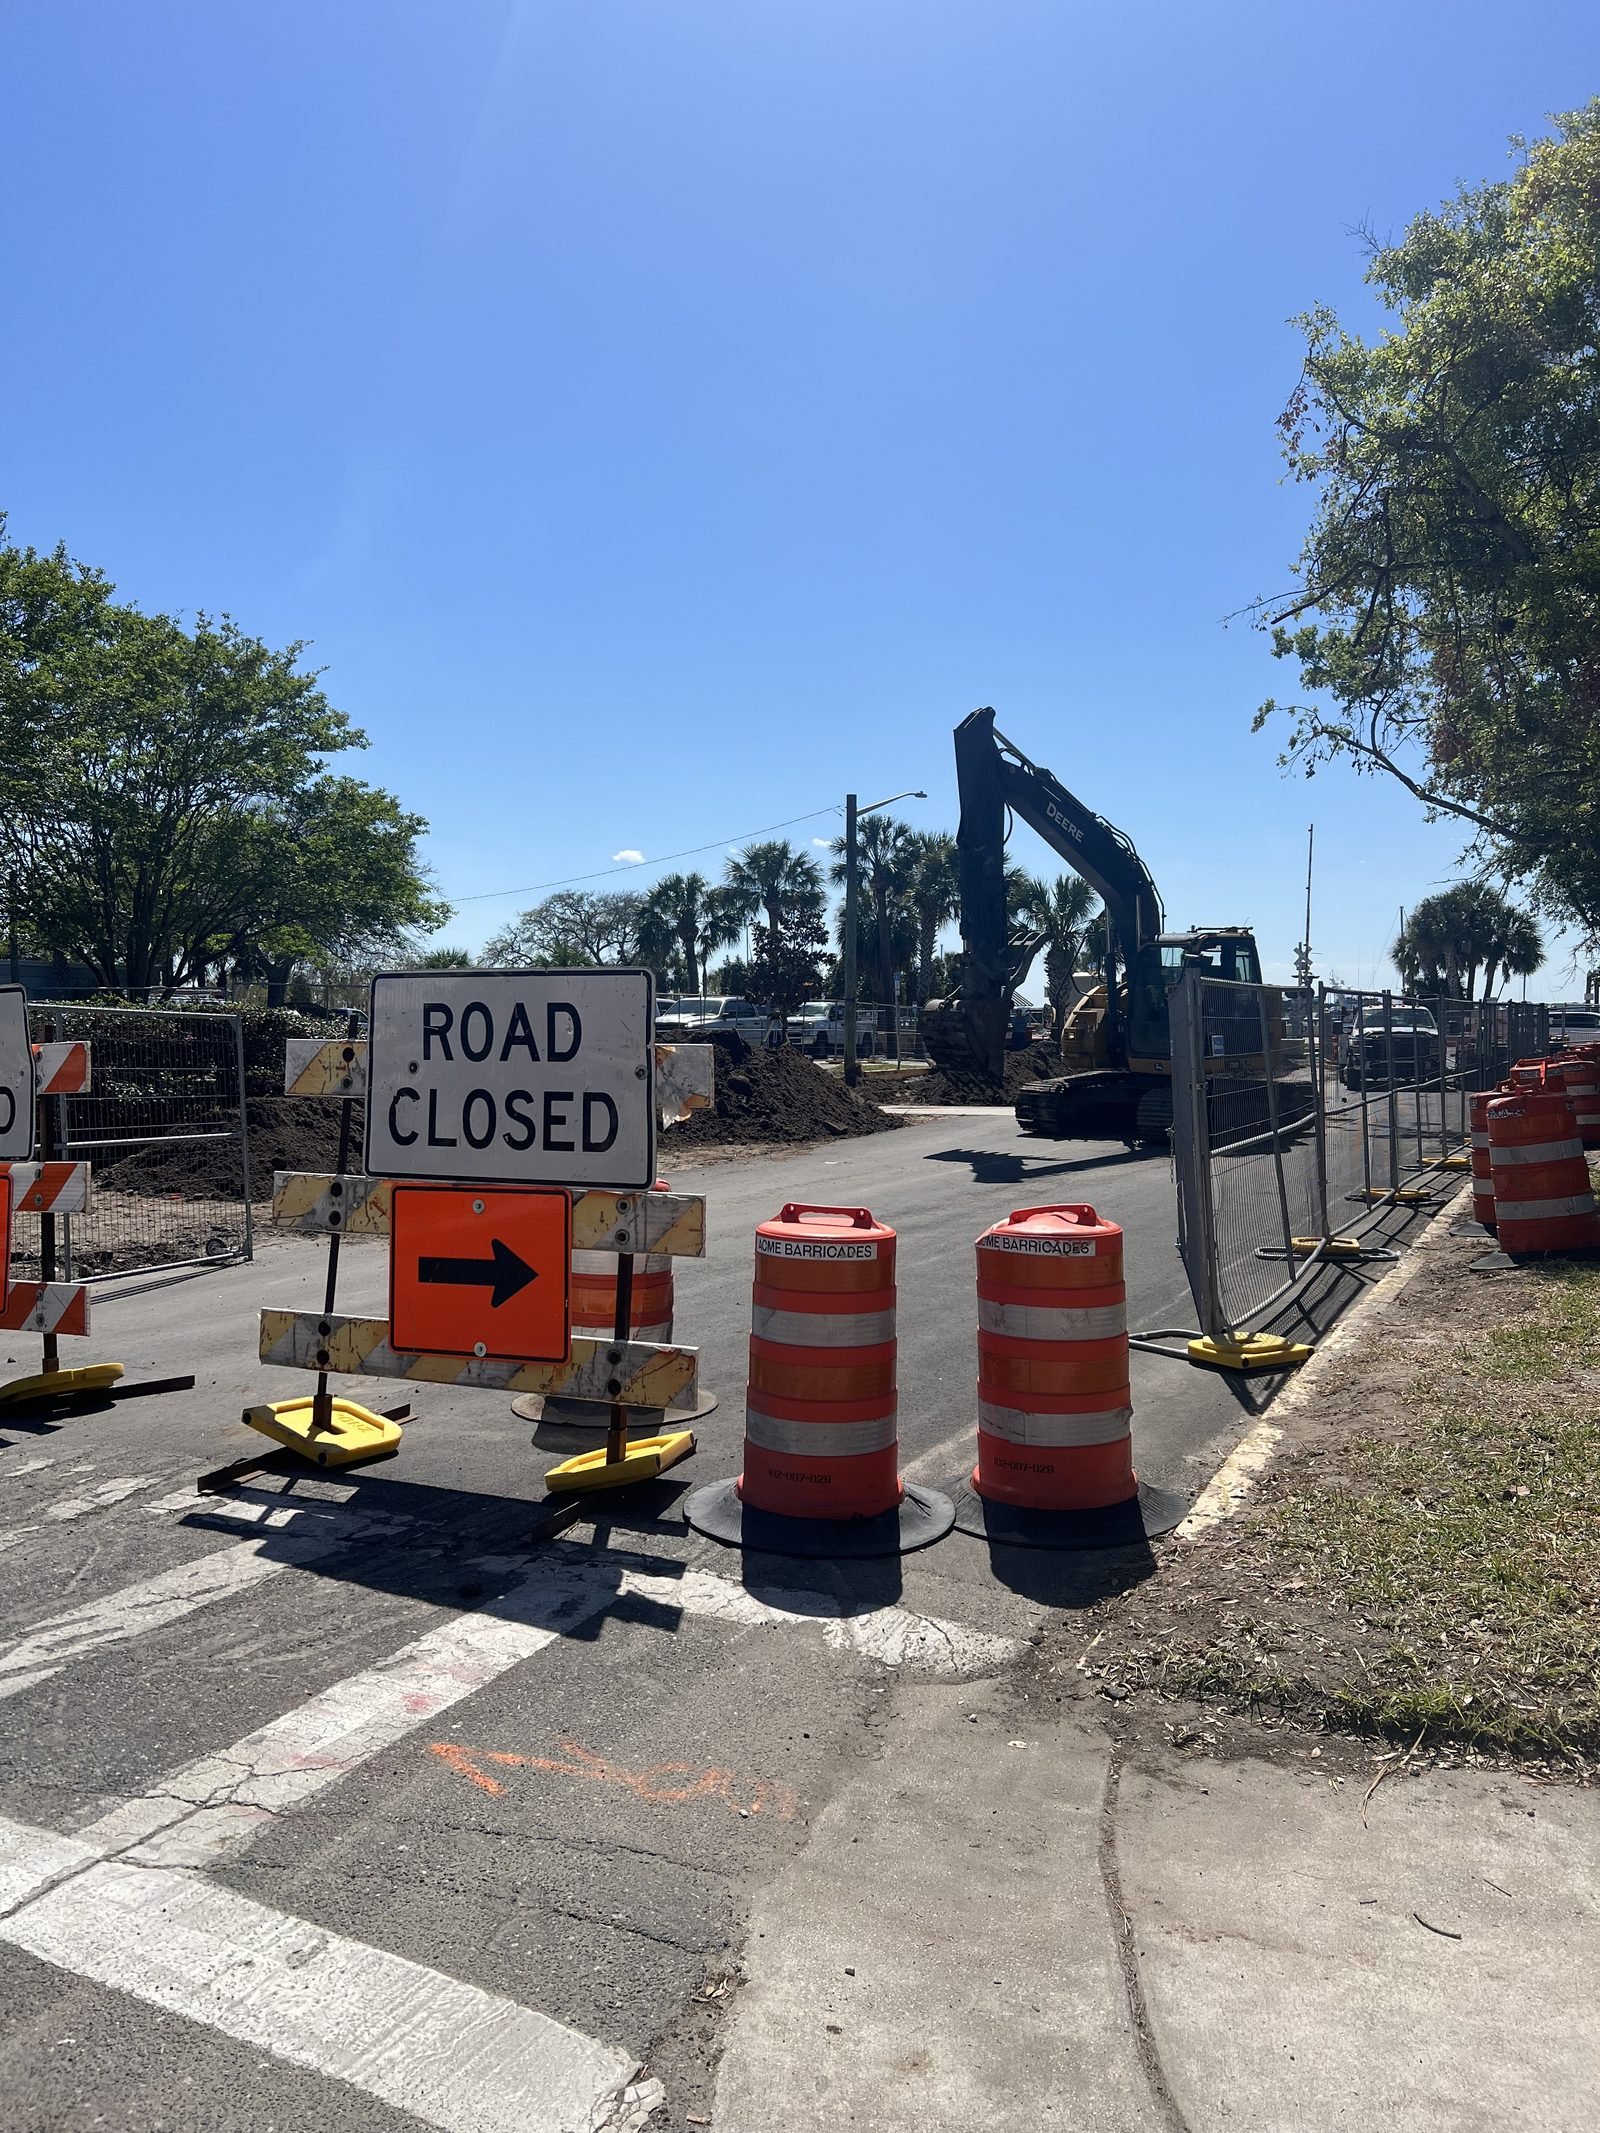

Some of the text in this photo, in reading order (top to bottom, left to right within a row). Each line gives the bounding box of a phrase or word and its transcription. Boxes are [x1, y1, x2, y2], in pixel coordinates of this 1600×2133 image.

[1046, 801, 1084, 843] DEERE
[422, 1001, 582, 1062] ROAD
[388, 1086, 619, 1153] CLOSED
[758, 1239, 872, 1259] ACME BARRICADES
[1002, 1237, 1090, 1255] BARRICADES
